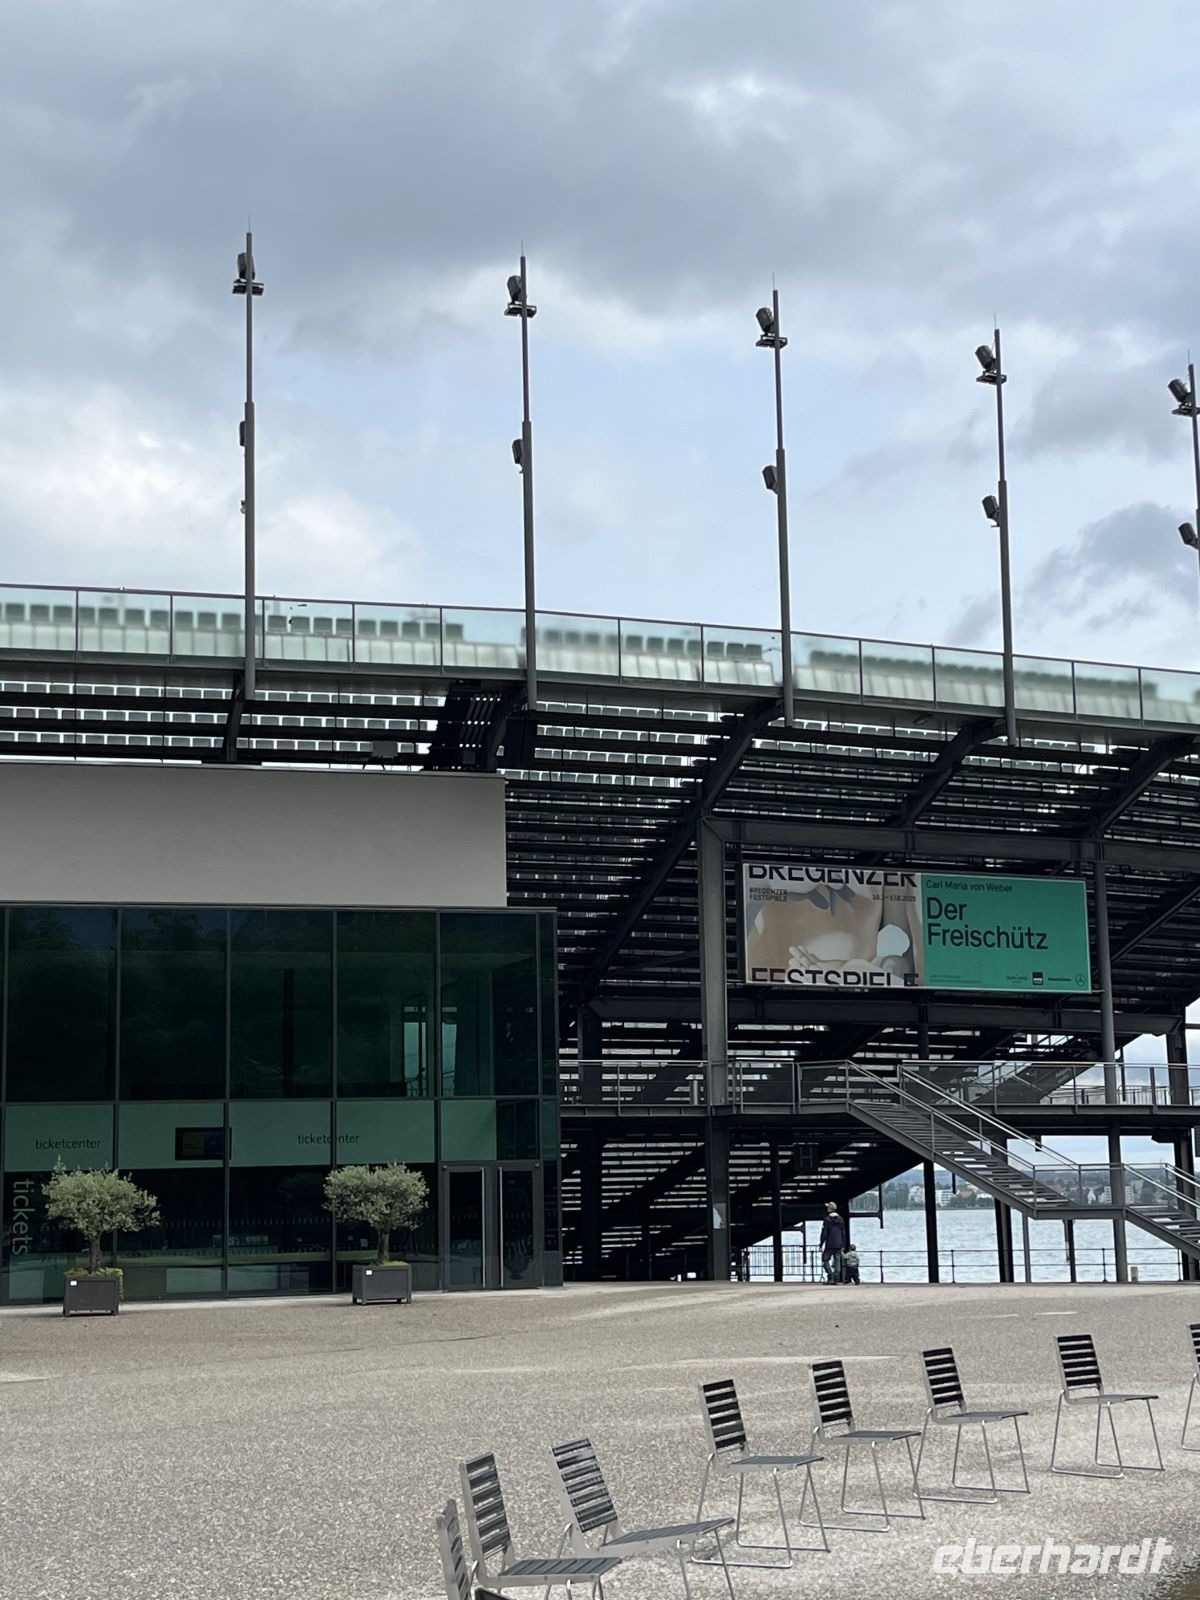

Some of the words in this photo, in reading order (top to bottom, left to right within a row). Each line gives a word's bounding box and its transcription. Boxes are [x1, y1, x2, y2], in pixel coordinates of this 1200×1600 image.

[748, 865, 918, 888] BREGENZER
[926, 879, 943, 889] Carl
[945, 881, 968, 891] Maria
[969, 883, 985, 892] von
[986, 883, 1013, 893] Weber
[927, 896, 968, 921] Der
[928, 923, 1048, 950] Freischütz
[751, 967, 919, 987] FESTSPIELE
[35, 1138, 101, 1150] ticketcenter
[11, 1178, 36, 1256] tickets
